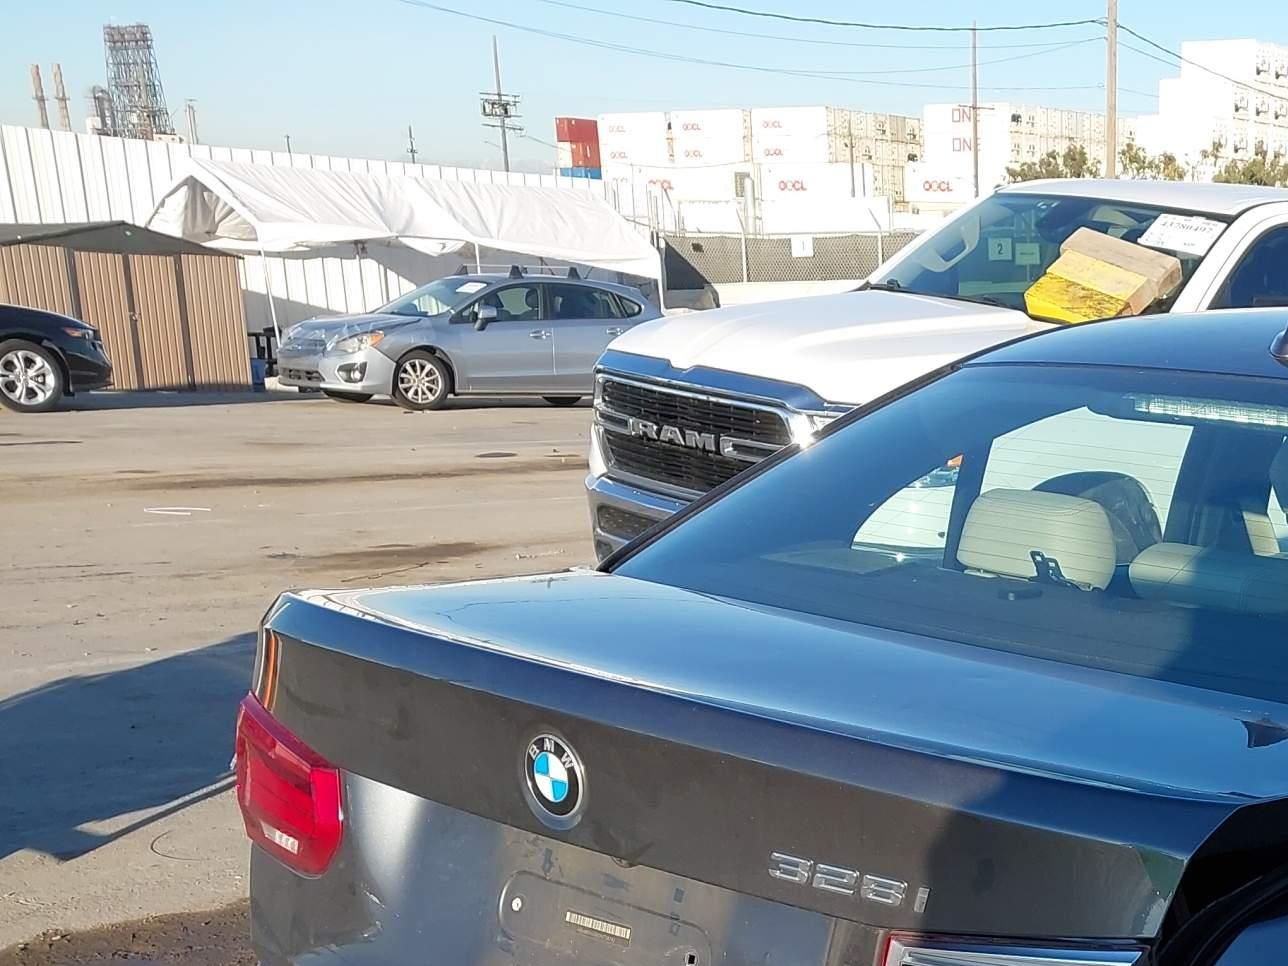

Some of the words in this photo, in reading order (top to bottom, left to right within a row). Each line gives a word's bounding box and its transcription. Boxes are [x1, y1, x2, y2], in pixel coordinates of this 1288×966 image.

[778, 180, 807, 191] OOCL
[923, 180, 953, 192] OOCL
[996, 242, 1004, 256] 2
[637, 420, 716, 451] RAM
[528, 738, 574, 769] BMW
